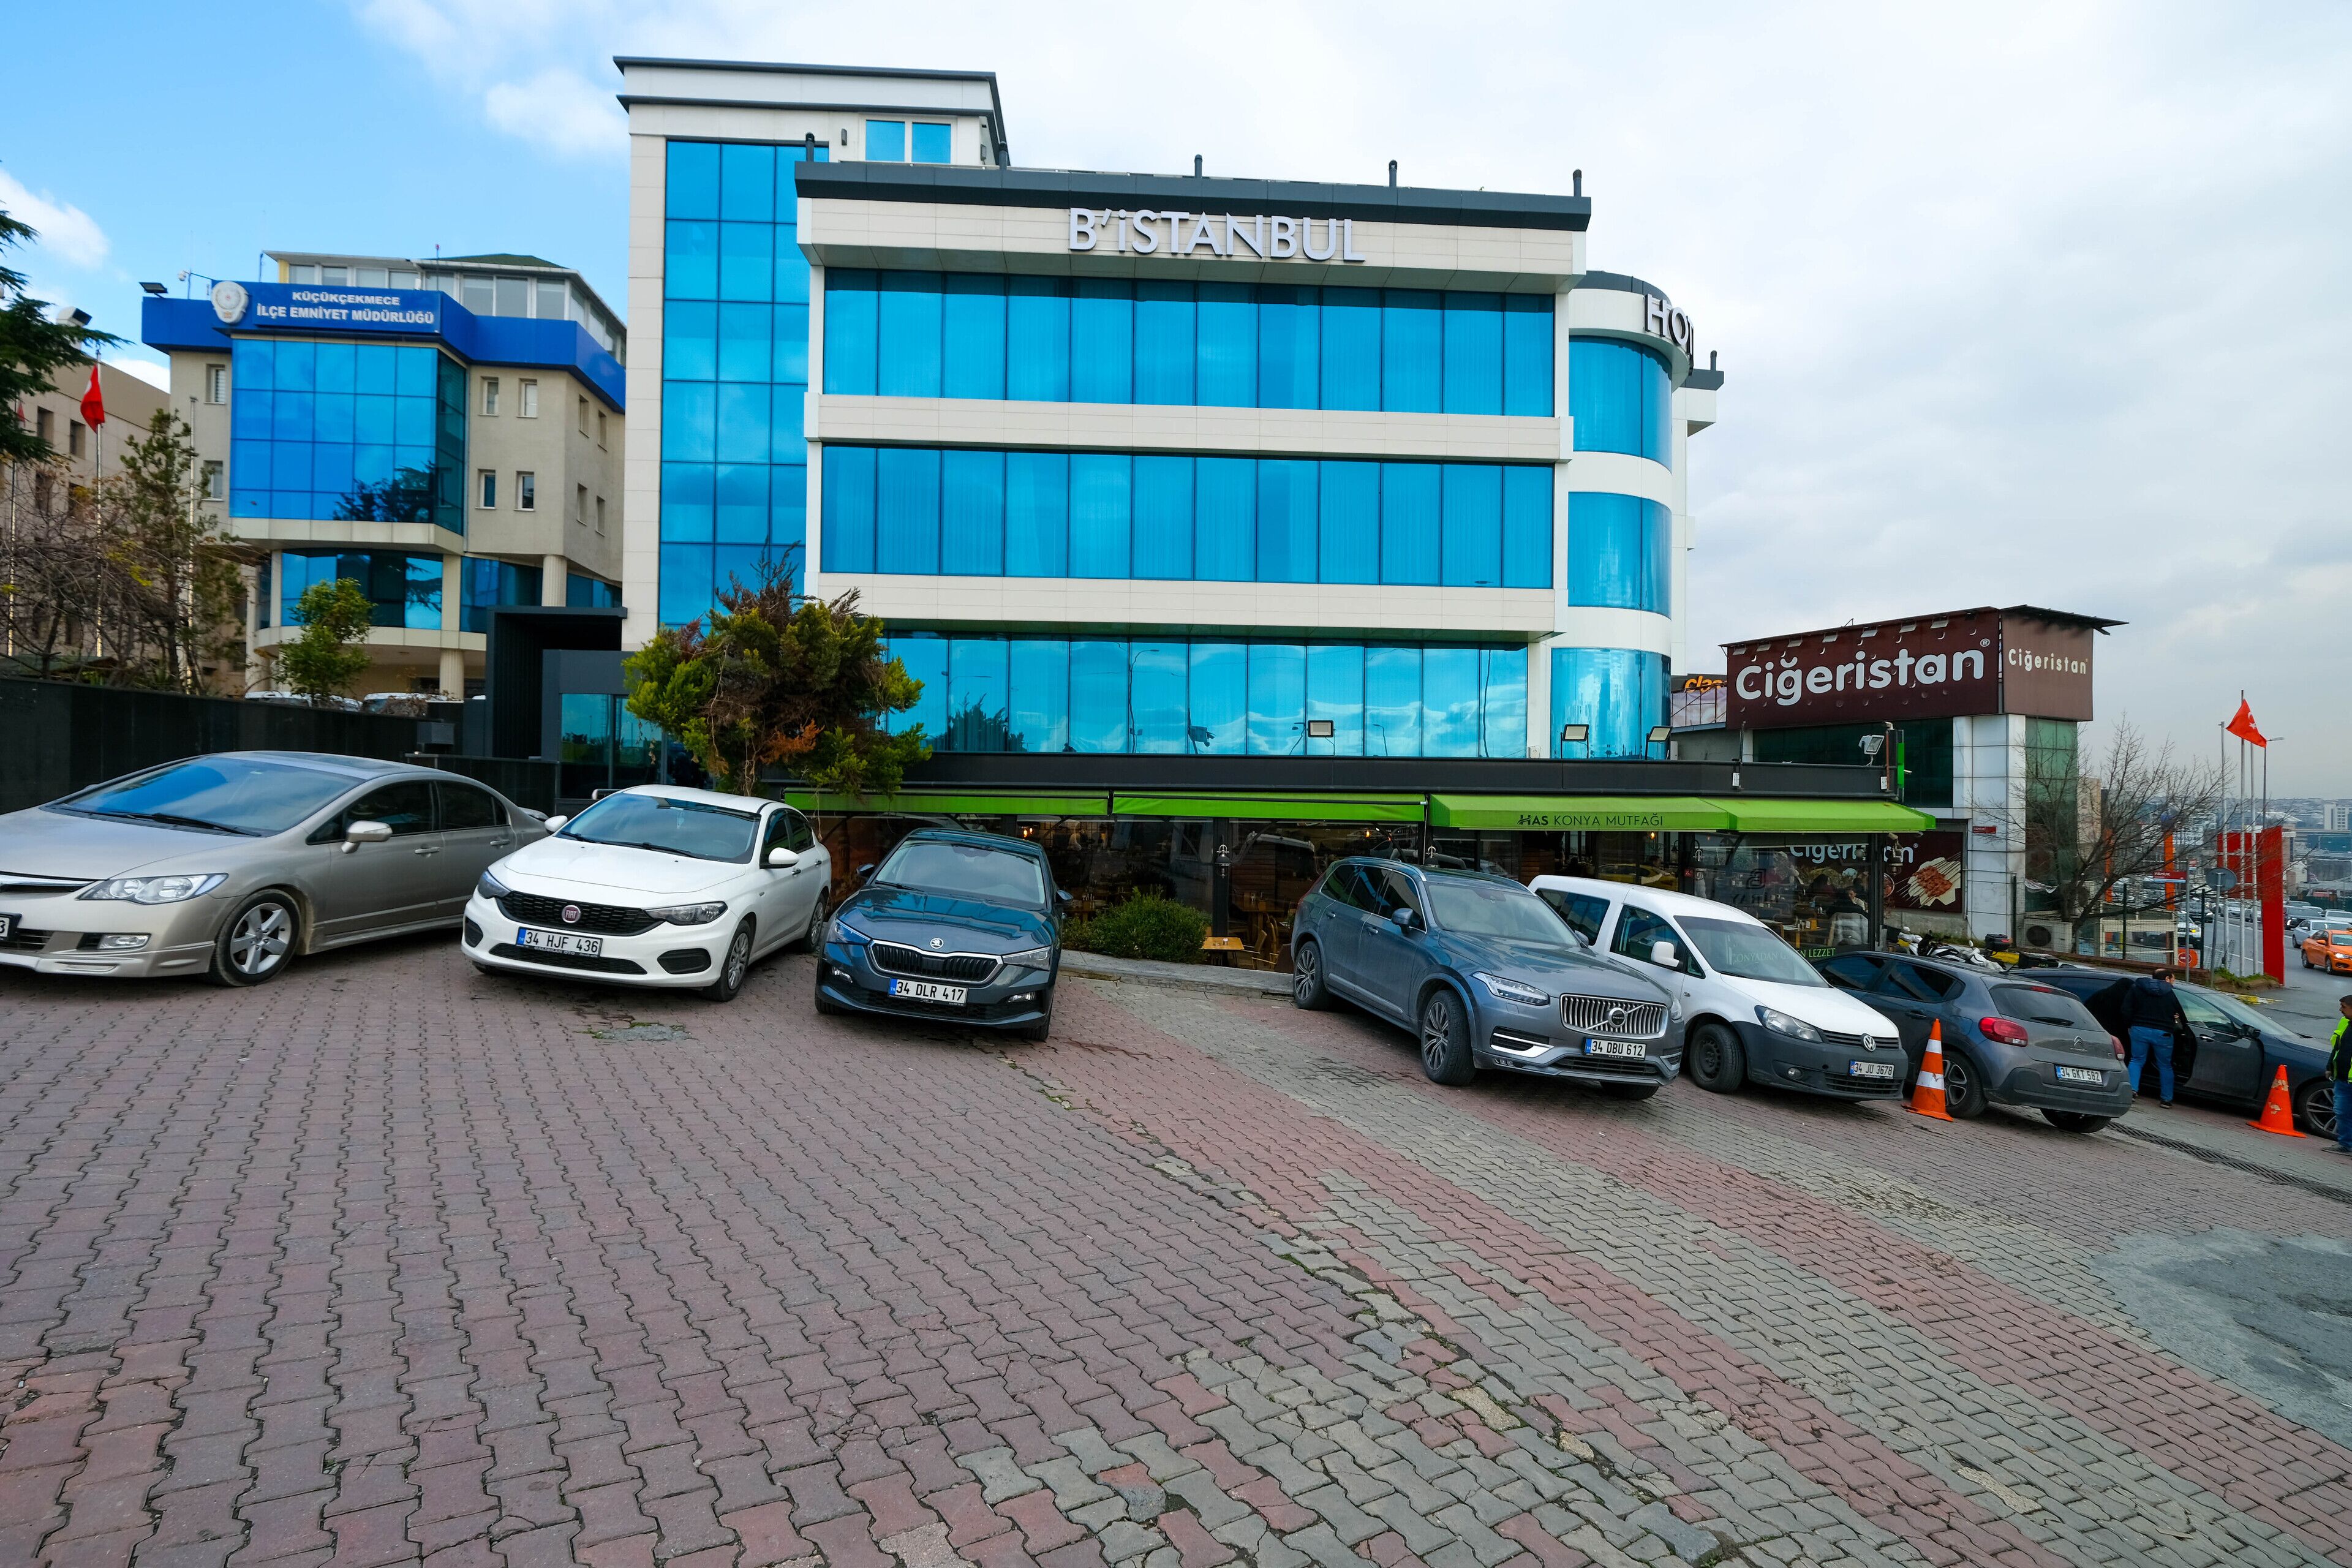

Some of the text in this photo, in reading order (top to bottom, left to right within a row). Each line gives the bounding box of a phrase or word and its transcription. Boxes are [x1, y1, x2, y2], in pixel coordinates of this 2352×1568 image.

[292, 291, 401, 306] KÜÇÜKÇEKMECE
[257, 303, 435, 324] İLÇE EMNİYET MÜDÜRLÜĞÜ
[2008, 648, 2087, 674] Ciğeristan
[1736, 648, 1985, 707] Ciğeristan
[1517, 813, 1664, 826] HAS KONYA MUTFAĞI
[565, 910, 578, 919] FIAT
[526, 932, 539, 945] 34
[546, 934, 569, 949] HJF
[576, 938, 599, 953] 436
[1809, 948, 1836, 958] LEZZET
[896, 981, 910, 995] 34
[916, 984, 937, 998] DLR
[943, 987, 964, 1001] 417
[1592, 1041, 1603, 1052] 34
[1607, 1042, 1624, 1054] DBU
[1626, 1044, 1643, 1057] 612
[1854, 1063, 1893, 1076] 34 JU 3678
[2060, 1068, 2100, 1081] 34 GKT 582
